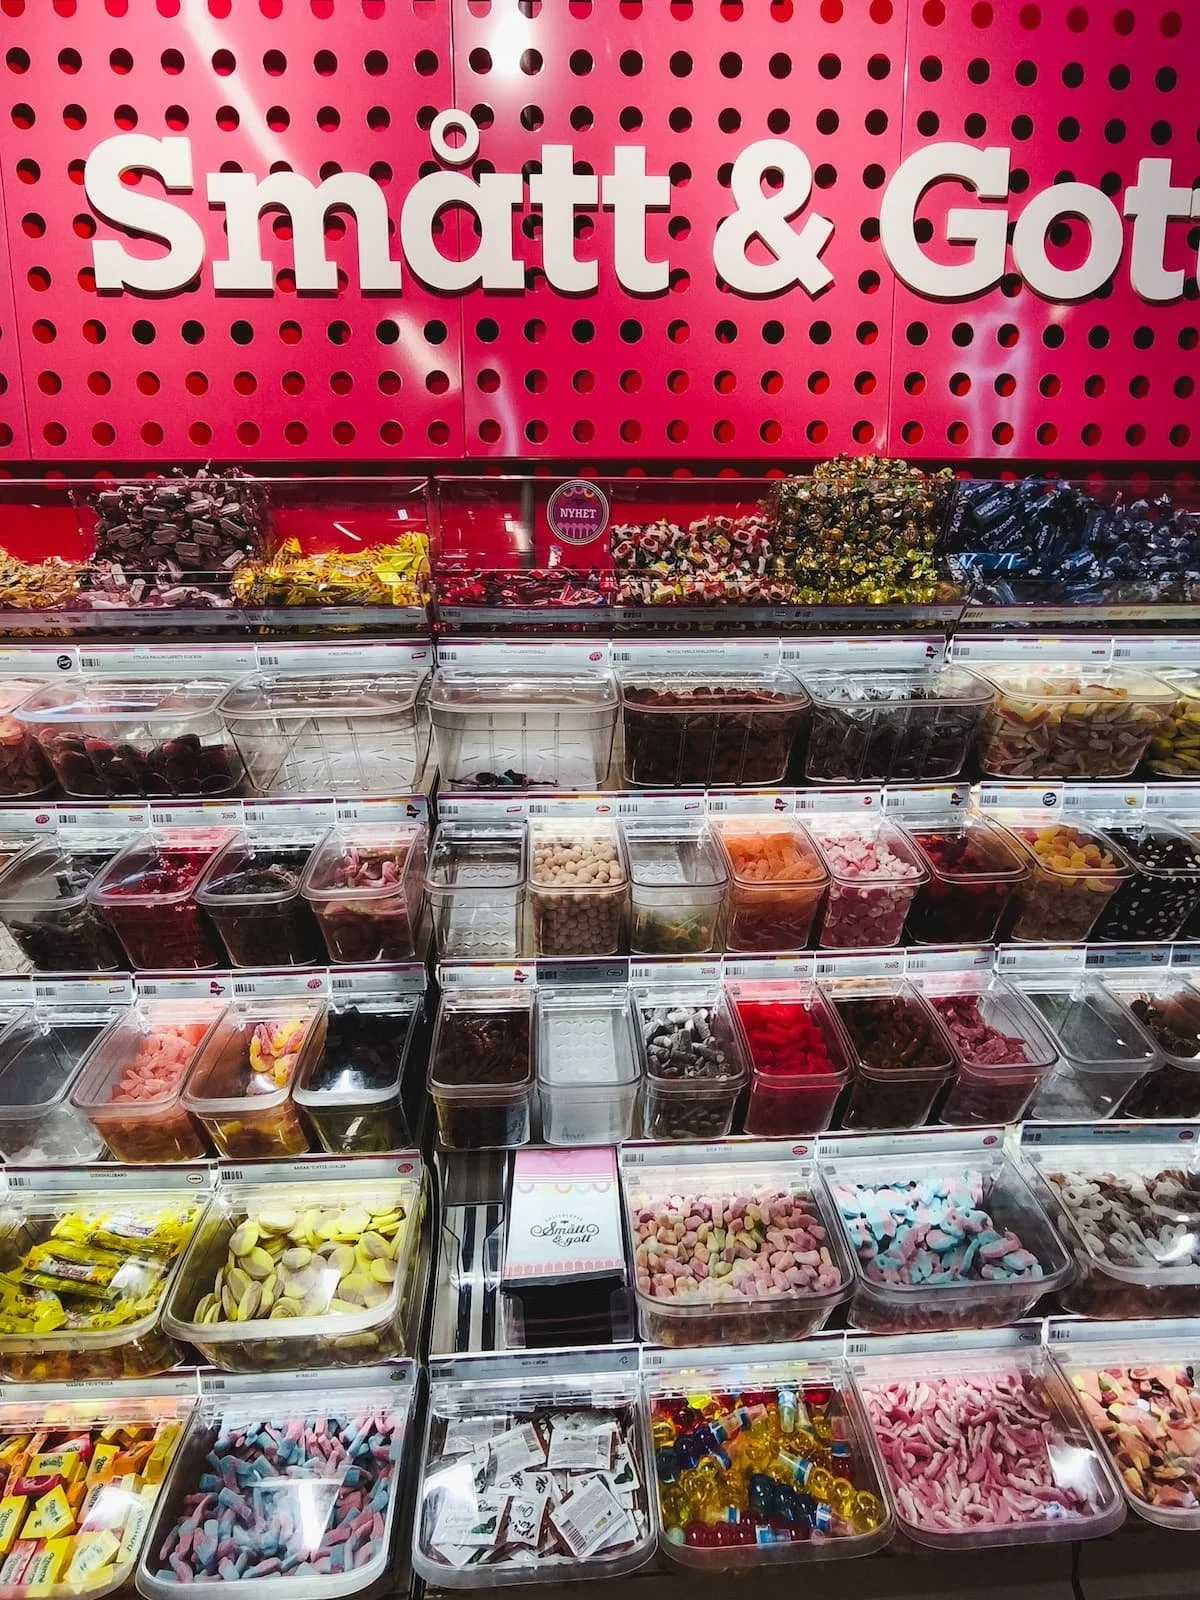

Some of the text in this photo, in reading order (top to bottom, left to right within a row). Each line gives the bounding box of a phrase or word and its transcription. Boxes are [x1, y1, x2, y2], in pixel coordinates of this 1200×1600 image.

[84, 109, 1200, 303] Smått & Got
[560, 507, 597, 519] NYHET
